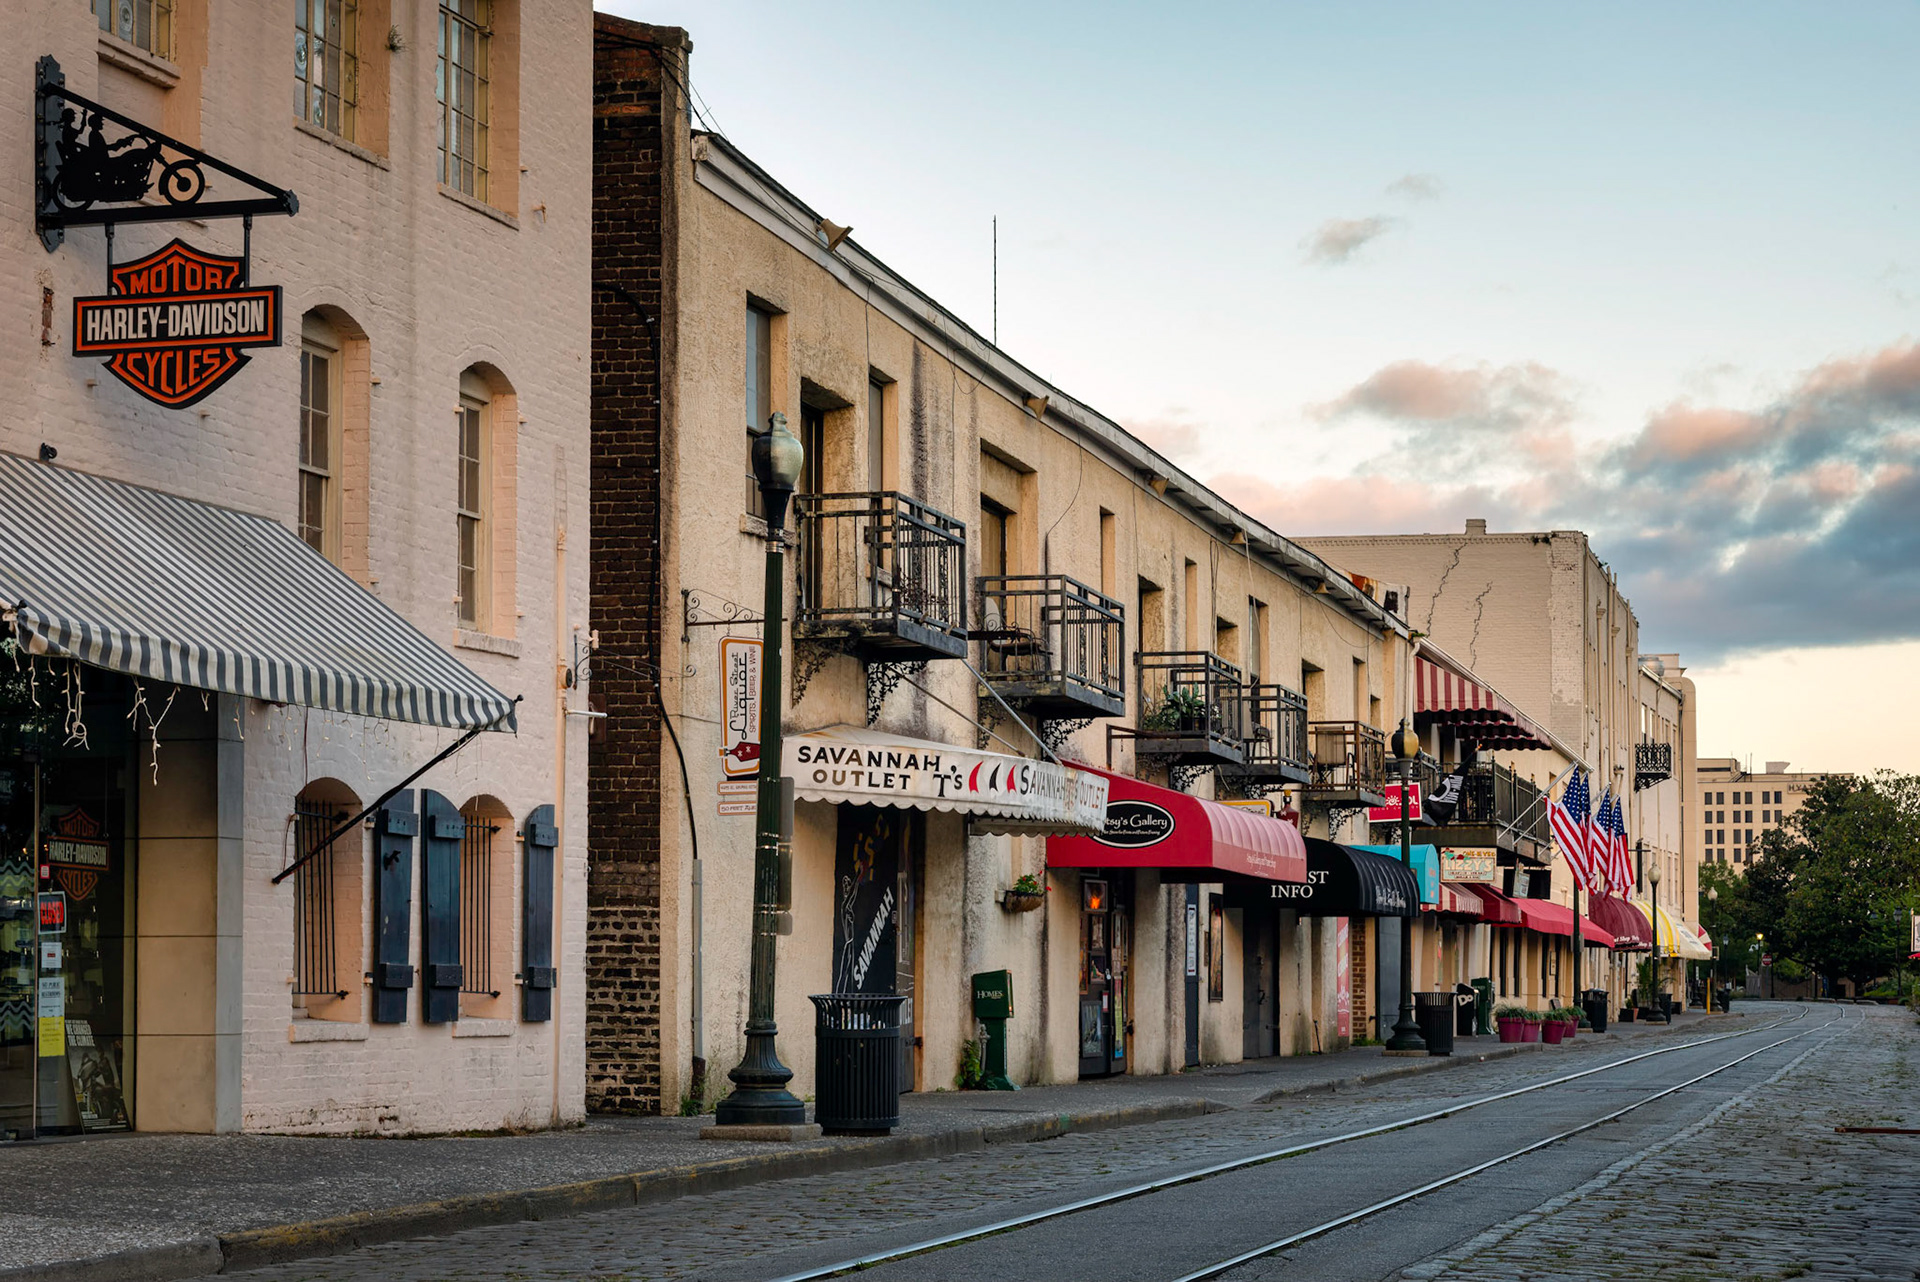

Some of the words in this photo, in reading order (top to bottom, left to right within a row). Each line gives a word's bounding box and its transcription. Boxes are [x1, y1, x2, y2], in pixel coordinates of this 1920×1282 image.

[130, 254, 223, 294] MOTOR
[87, 300, 265, 341] HARLEY-DAVIDSON
[127, 348, 221, 395] CYCLES
[729, 652, 738, 686] Street
[749, 666, 757, 674] &
[729, 652, 754, 740] Liquor
[749, 675, 757, 697] BEER
[729, 689, 739, 719] River
[797, 746, 941, 772] SAVANNAH
[812, 769, 911, 790] OUTLET
[1020, 765, 1066, 802] SAVANNAH
[1079, 781, 1105, 810] OUTLET
[63, 815, 94, 837] MOTOR
[1104, 816, 1128, 830] tsy's
[1129, 814, 1168, 830] Gallery
[49, 841, 107, 866] HARLEY-DAVIDSON
[1444, 859, 1492, 872] LIZZY'S
[62, 870, 93, 896] CYCLES
[1308, 871, 1329, 884] ST
[1270, 885, 1314, 898] INFO
[40, 901, 64, 924] CLOSED
[854, 886, 895, 990] SAVANNAH
[977, 989, 1002, 999] HOMES
